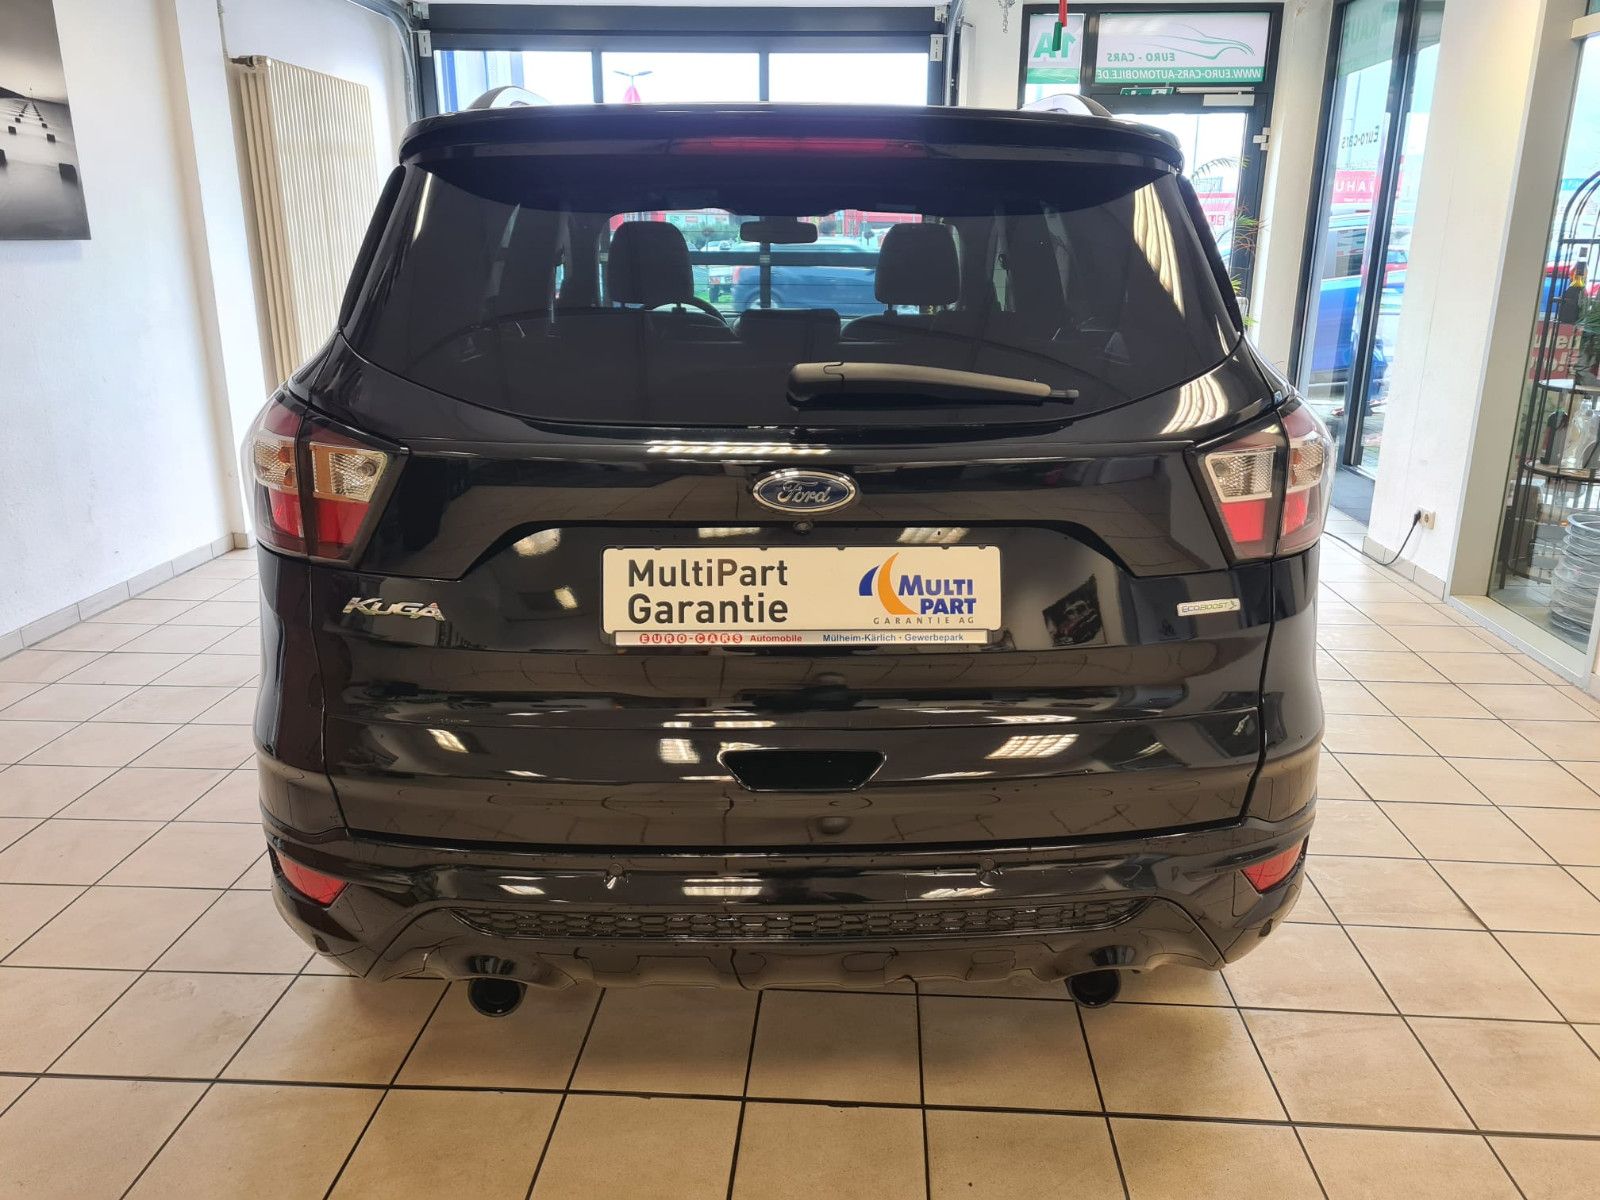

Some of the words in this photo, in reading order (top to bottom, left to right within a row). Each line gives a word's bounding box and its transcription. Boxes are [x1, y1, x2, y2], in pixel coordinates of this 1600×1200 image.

[777, 480, 832, 503] Ford
[628, 558, 788, 587] MultiPart
[342, 597, 445, 621] KUGA
[628, 592, 788, 624] Garantie
[920, 598, 976, 615] PART
[873, 616, 951, 625] GARANTIE
[959, 616, 974, 625] AG
[639, 633, 743, 644] EURO-CARS
[750, 634, 803, 643] Automobile
[822, 633, 897, 643] Mülheim-Kärlich
[904, 633, 964, 644] Gewerbepark
